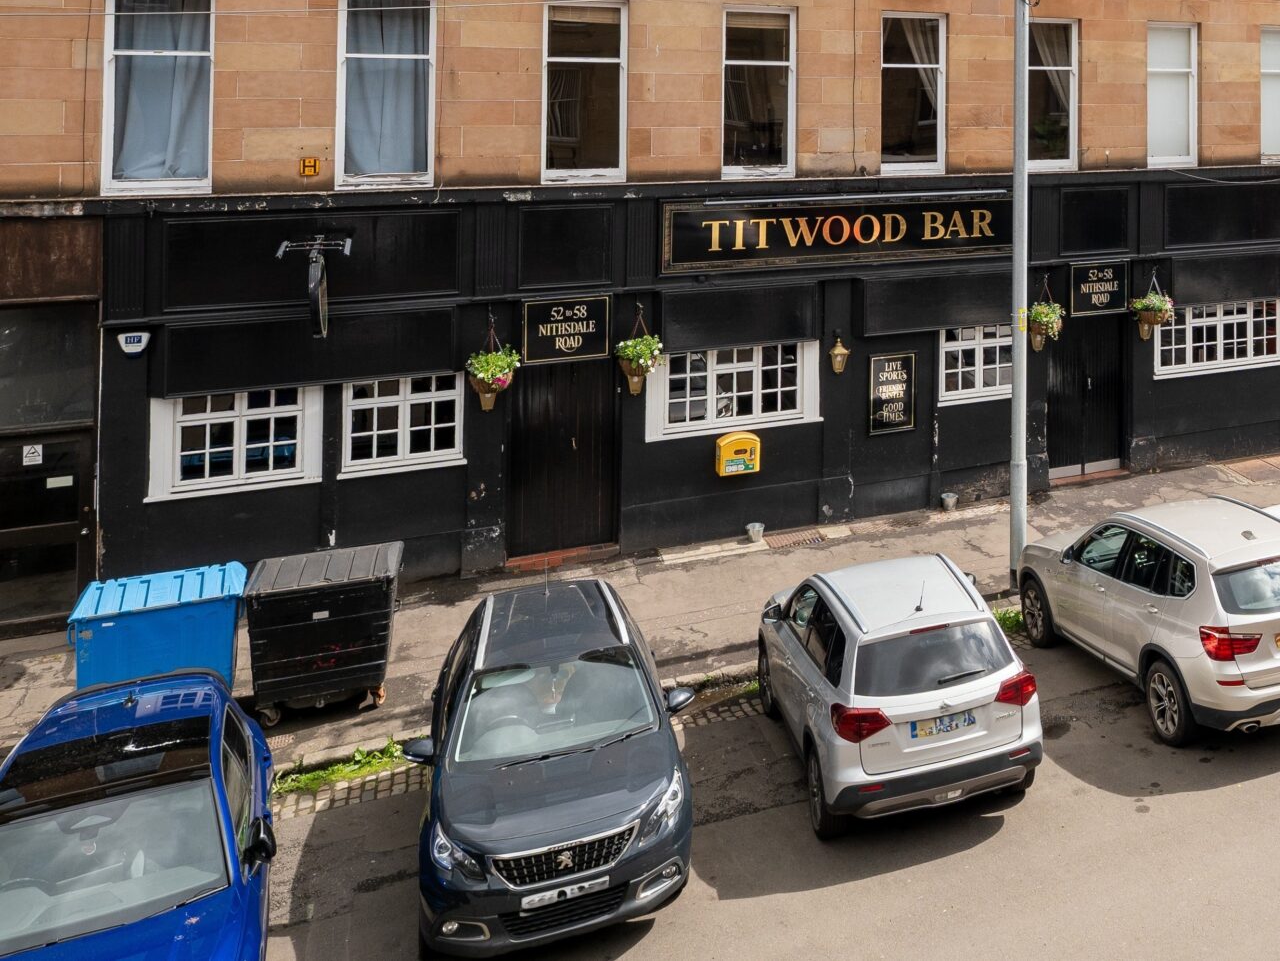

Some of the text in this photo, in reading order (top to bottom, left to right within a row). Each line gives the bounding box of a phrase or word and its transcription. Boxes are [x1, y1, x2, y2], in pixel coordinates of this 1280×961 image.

[701, 208, 996, 252] TITWOOD BAR
[1088, 269, 1098, 281] 52
[1103, 268, 1113, 279] 58
[1080, 280, 1119, 294] NITHSDALE
[1091, 292, 1110, 307] ROAD
[550, 304, 588, 321] 52 to 58
[538, 320, 596, 337] NITHSDALE
[555, 335, 583, 353] ROAD
[885, 361, 902, 372] LIVE
[879, 370, 907, 382] SPORTS
[883, 402, 904, 413] GOOD
